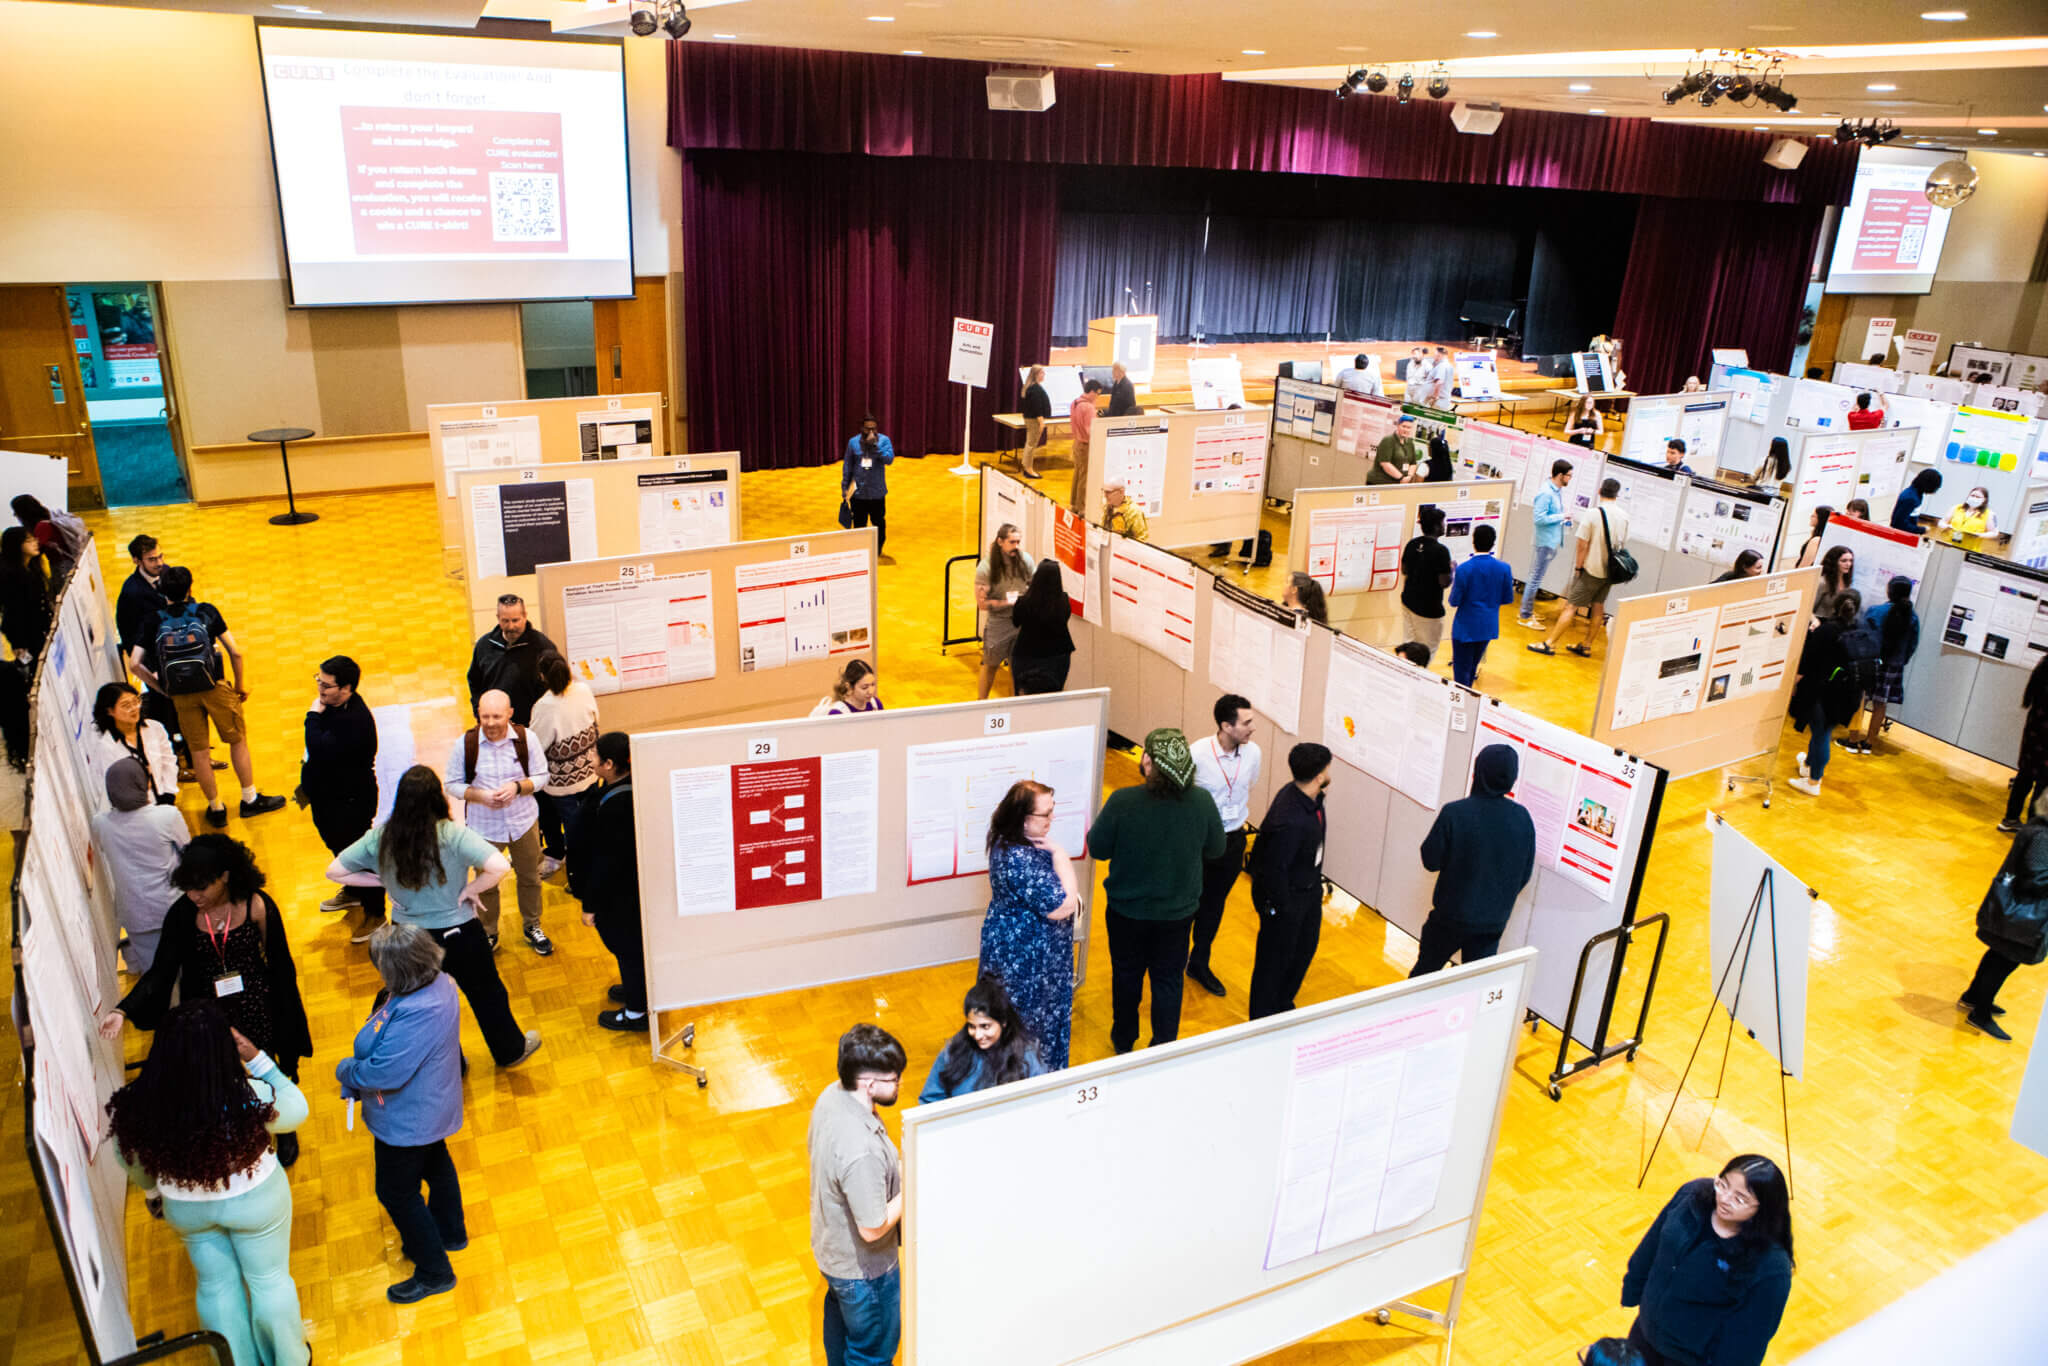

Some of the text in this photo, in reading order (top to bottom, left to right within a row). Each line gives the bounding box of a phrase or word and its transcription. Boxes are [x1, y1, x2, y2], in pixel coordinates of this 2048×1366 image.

[273, 64, 335, 80] CURE
[344, 64, 409, 79] Complete
[416, 65, 440, 80] the
[958, 322, 989, 336] CURE
[795, 545, 805, 554] 26
[621, 568, 634, 576] 25
[1450, 691, 1461, 702] 36
[990, 718, 1005, 729] 30
[755, 743, 771, 755] 29
[1621, 764, 1636, 779] 35
[1487, 989, 1503, 1004] 34
[1077, 1086, 1098, 1104] 33
